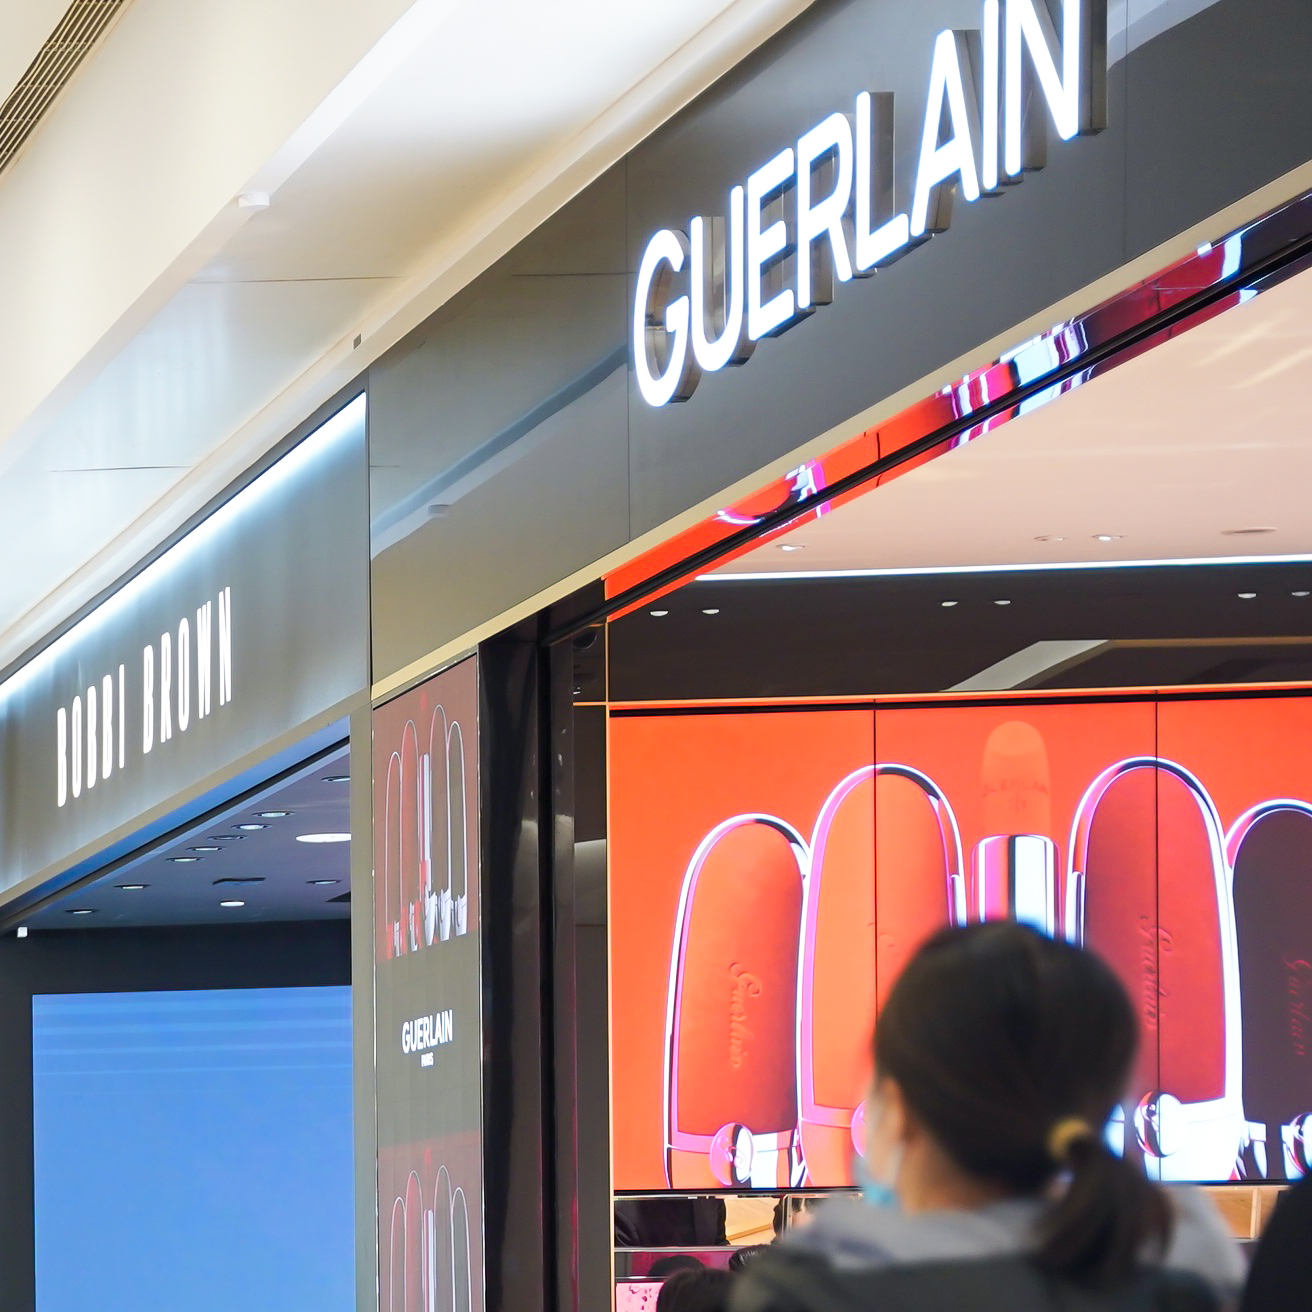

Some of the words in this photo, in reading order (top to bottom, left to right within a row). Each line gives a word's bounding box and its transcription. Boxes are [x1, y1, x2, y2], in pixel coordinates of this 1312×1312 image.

[633, 0, 1082, 407] GUERLAIN
[57, 663, 125, 808] BOBBI
[143, 586, 232, 754] BROWN
[402, 1009, 453, 1054] GUERLAIN
